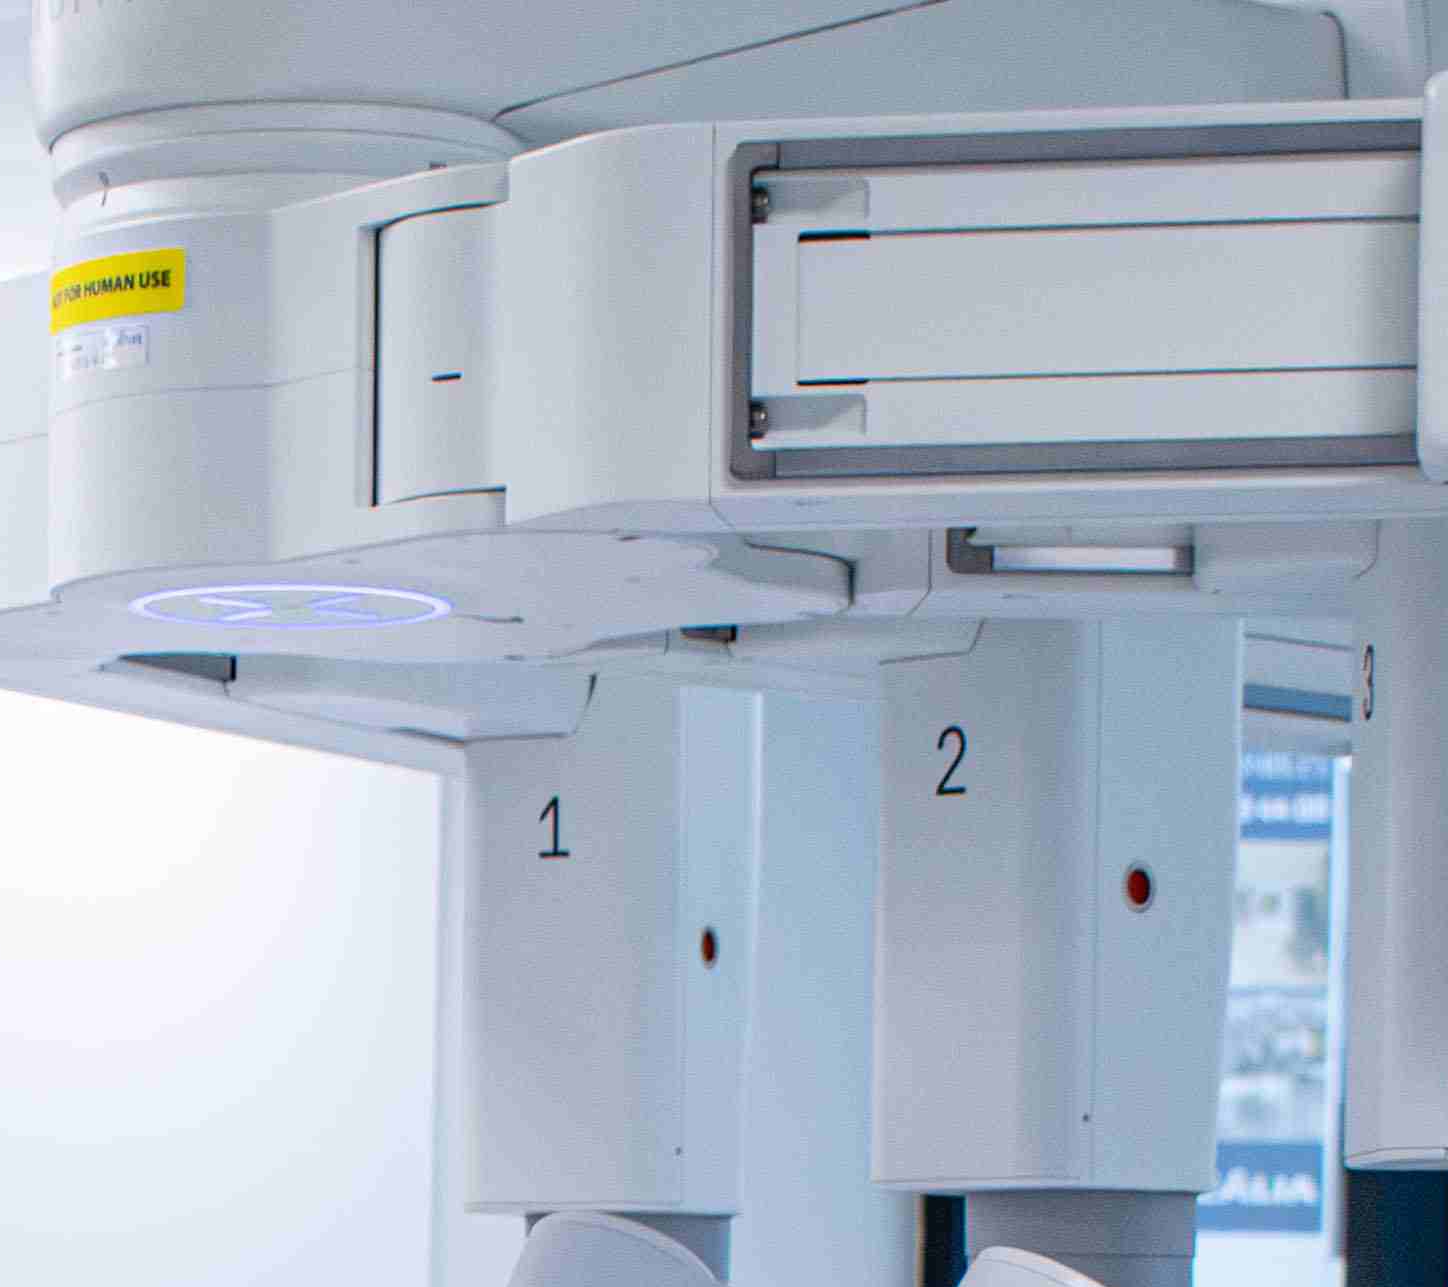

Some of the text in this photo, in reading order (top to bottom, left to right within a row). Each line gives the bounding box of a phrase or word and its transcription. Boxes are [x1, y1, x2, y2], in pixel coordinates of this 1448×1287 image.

[64, 283, 82, 303] FOR
[83, 273, 135, 298] HUMAN
[138, 268, 172, 290] USE
[1361, 642, 1375, 722] 3
[936, 724, 968, 797] 2
[538, 795, 571, 859] 1
